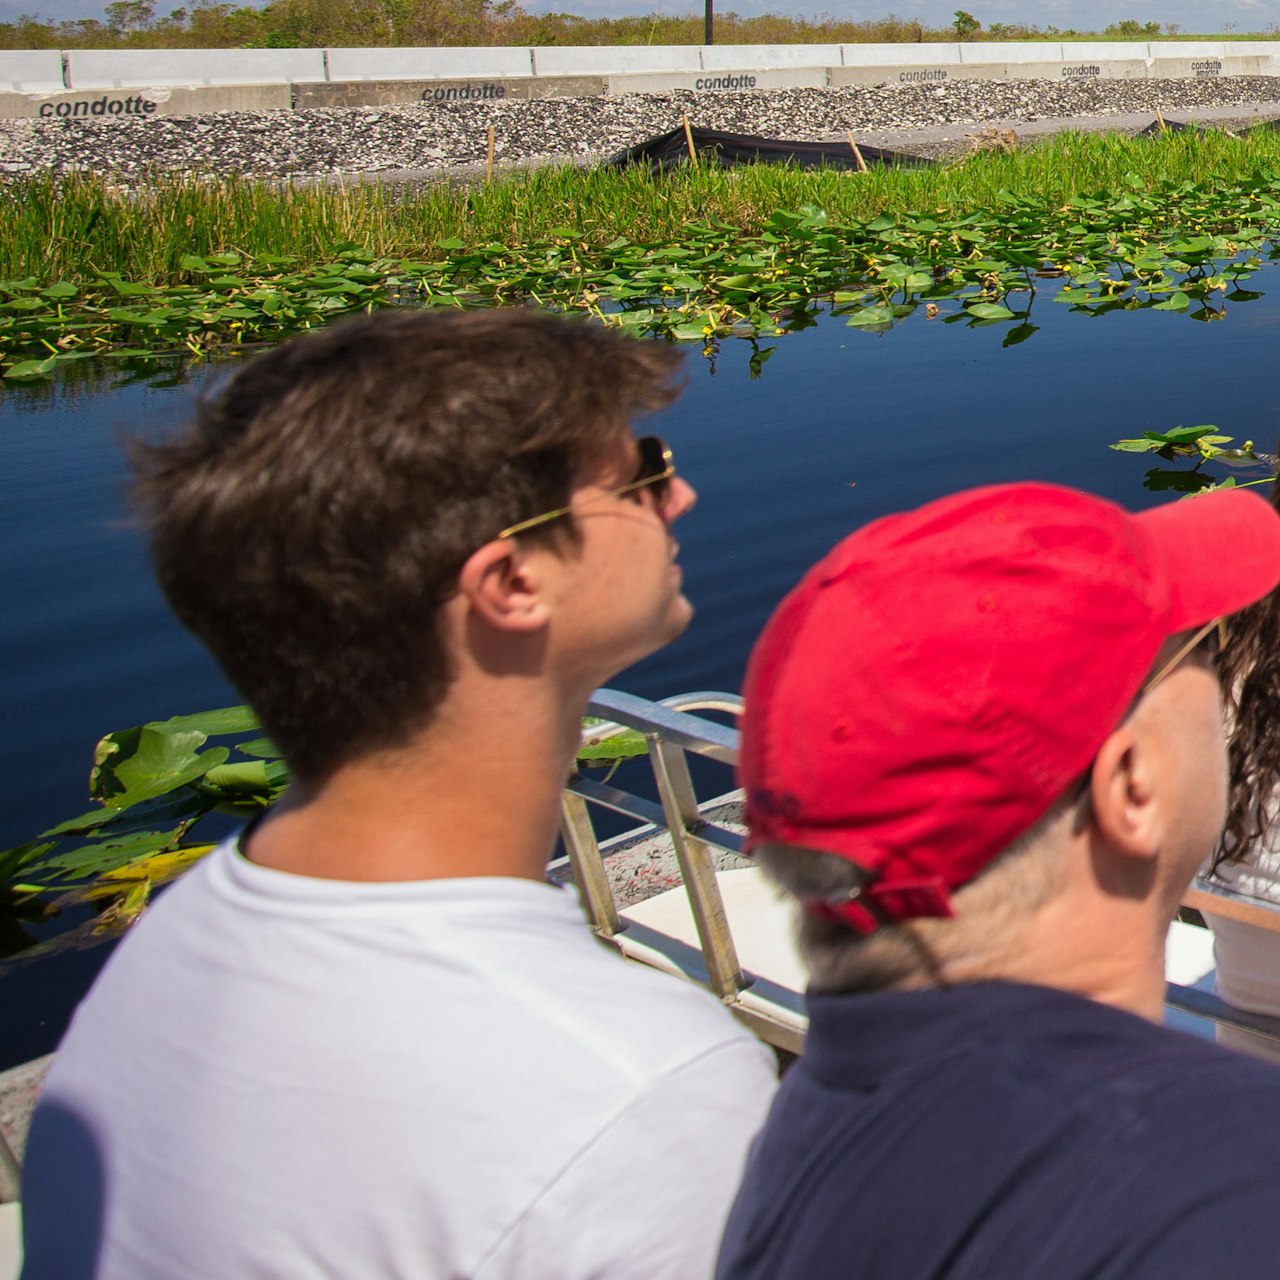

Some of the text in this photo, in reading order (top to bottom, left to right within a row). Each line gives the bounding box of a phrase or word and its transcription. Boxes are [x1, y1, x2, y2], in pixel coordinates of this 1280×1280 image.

[1061, 64, 1100, 76] condotte
[1191, 59, 1222, 70] condotte
[695, 74, 756, 90] condotte
[899, 68, 947, 82] condotte
[421, 83, 505, 101] condotte
[39, 95, 157, 117] condotte
